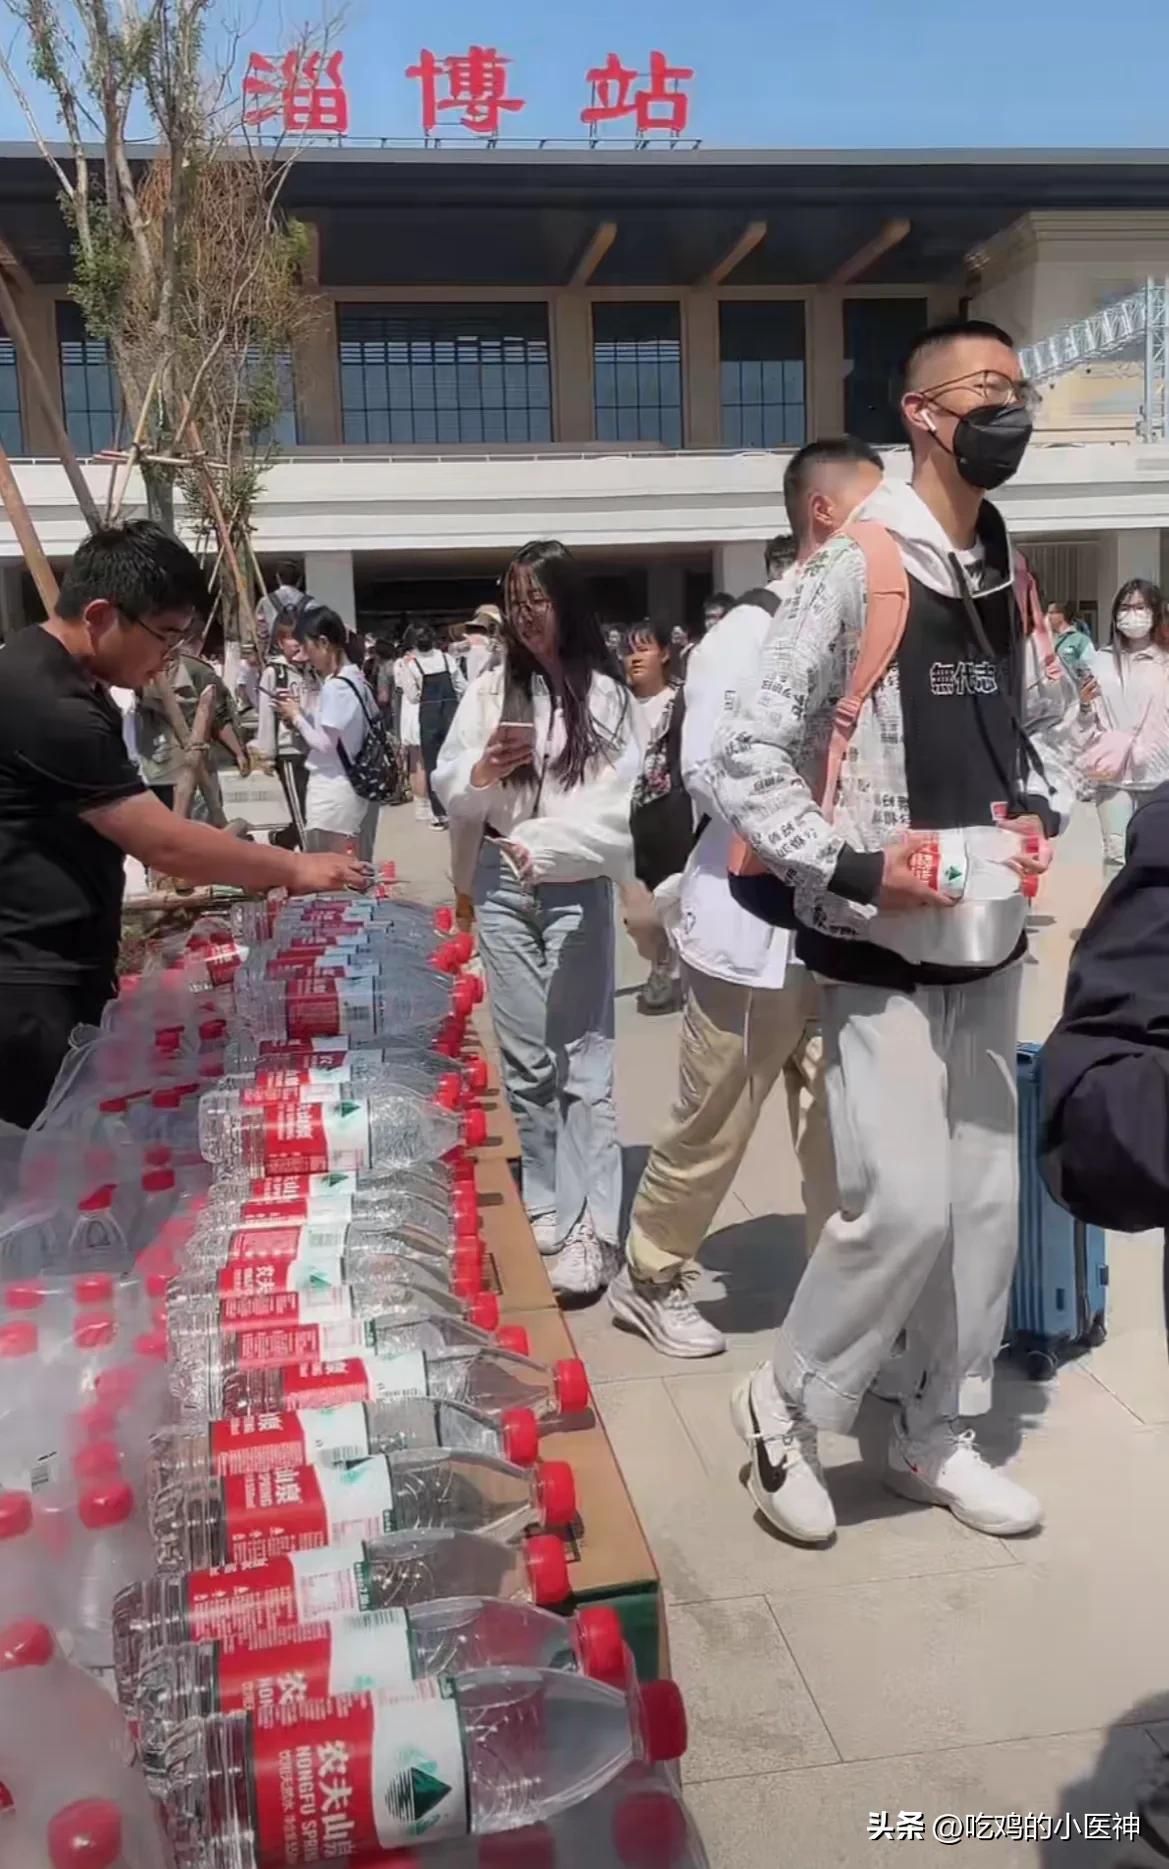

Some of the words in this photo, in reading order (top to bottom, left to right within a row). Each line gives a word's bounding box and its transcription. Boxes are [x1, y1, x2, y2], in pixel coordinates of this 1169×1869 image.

[243, 45, 695, 133] 淄博站
[275, 1466, 303, 1504] 山泉
[296, 1746, 316, 1816] NONGFU
[317, 1740, 356, 1858] 农夫山泉
